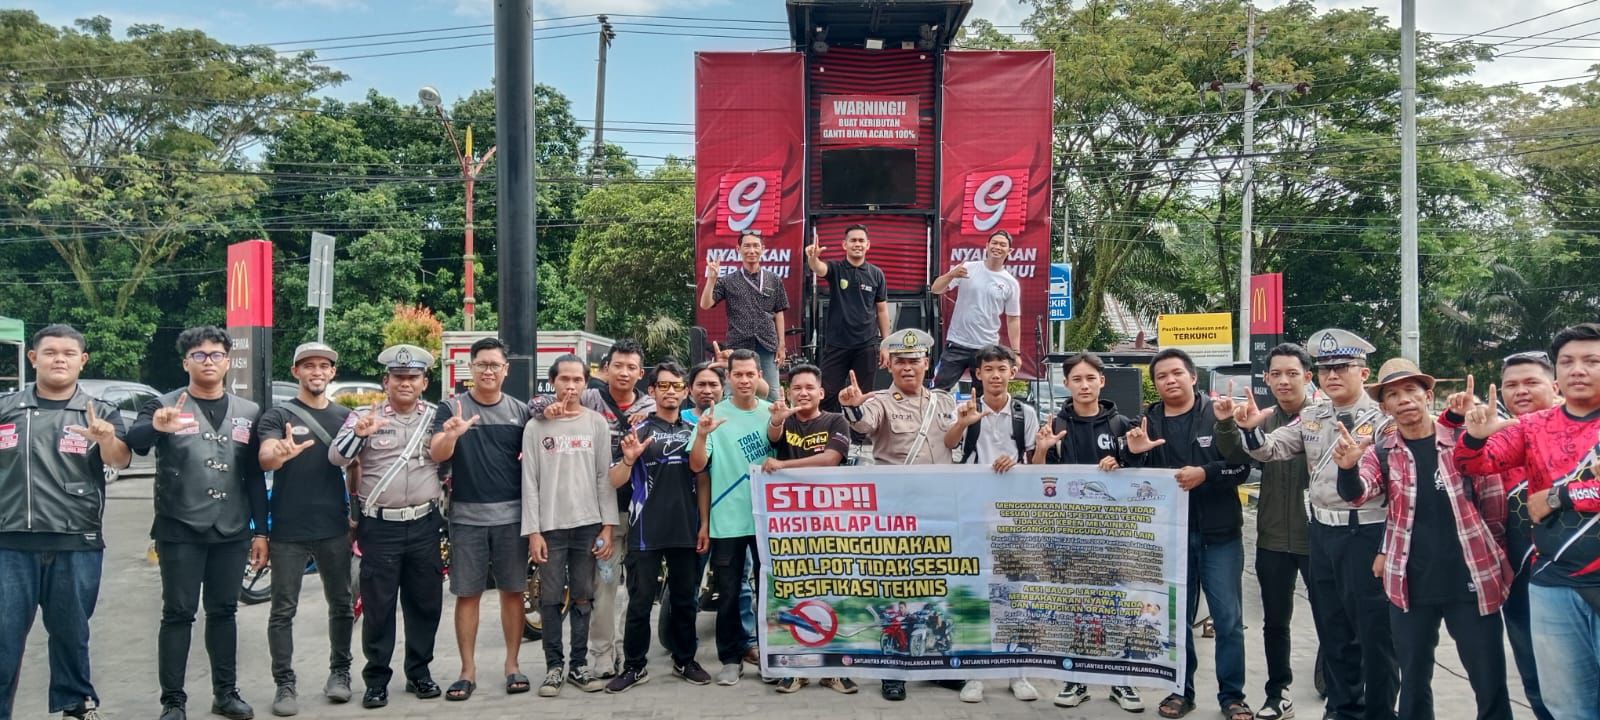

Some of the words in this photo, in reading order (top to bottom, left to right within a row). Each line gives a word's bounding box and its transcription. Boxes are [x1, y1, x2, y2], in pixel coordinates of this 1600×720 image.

[833, 101, 907, 116] WARNING!!
[838, 119, 857, 128] BUAT
[859, 119, 900, 128] KERIBUTAN
[823, 130, 846, 139] GANTI
[847, 130, 867, 139] BIAYA
[869, 130, 893, 139] ACARA
[895, 131, 915, 139] 100%
[1050, 309, 1065, 317] BIL
[1173, 332, 1217, 340] TERKUNCI
[233, 338, 249, 350] ERIMA
[773, 486, 870, 509] STOP!!
[996, 502, 1061, 510] MENGGUNAKAN
[1062, 503, 1102, 512] KNALPOT
[1128, 507, 1156, 515] TIDAK
[1031, 510, 1066, 518] DENGAN
[1067, 511, 1119, 520] SPESIFIKASI
[1120, 514, 1151, 523] TEKNIS
[768, 517, 807, 532] AKSI
[811, 516, 871, 532] BALAP
[875, 515, 917, 532] LIAR
[1056, 519, 1084, 527] KEREN
[1085, 520, 1137, 529] MELAINKAN
[1056, 527, 1103, 536] PENGGUNA
[1104, 529, 1132, 537] JALAN
[1134, 532, 1155, 540] LAIN
[769, 537, 806, 555] DAN
[807, 536, 951, 554] MENGGUNAKAN
[772, 557, 854, 577] KNALPOT
[855, 558, 911, 576] TIDAK
[912, 557, 980, 576] SESUAI
[774, 578, 879, 599] SPESIFIKASI
[880, 579, 947, 598] TEKNIS
[1023, 585, 1043, 593] AKSI
[1045, 586, 1073, 595] BALAP
[1075, 588, 1097, 596] LIAR
[1098, 590, 1127, 598] DAPAT
[1083, 597, 1115, 607] NYAWA
[1011, 601, 1029, 609] DAN
[1086, 606, 1117, 615] ORANG
[1119, 609, 1141, 617] LAIN
